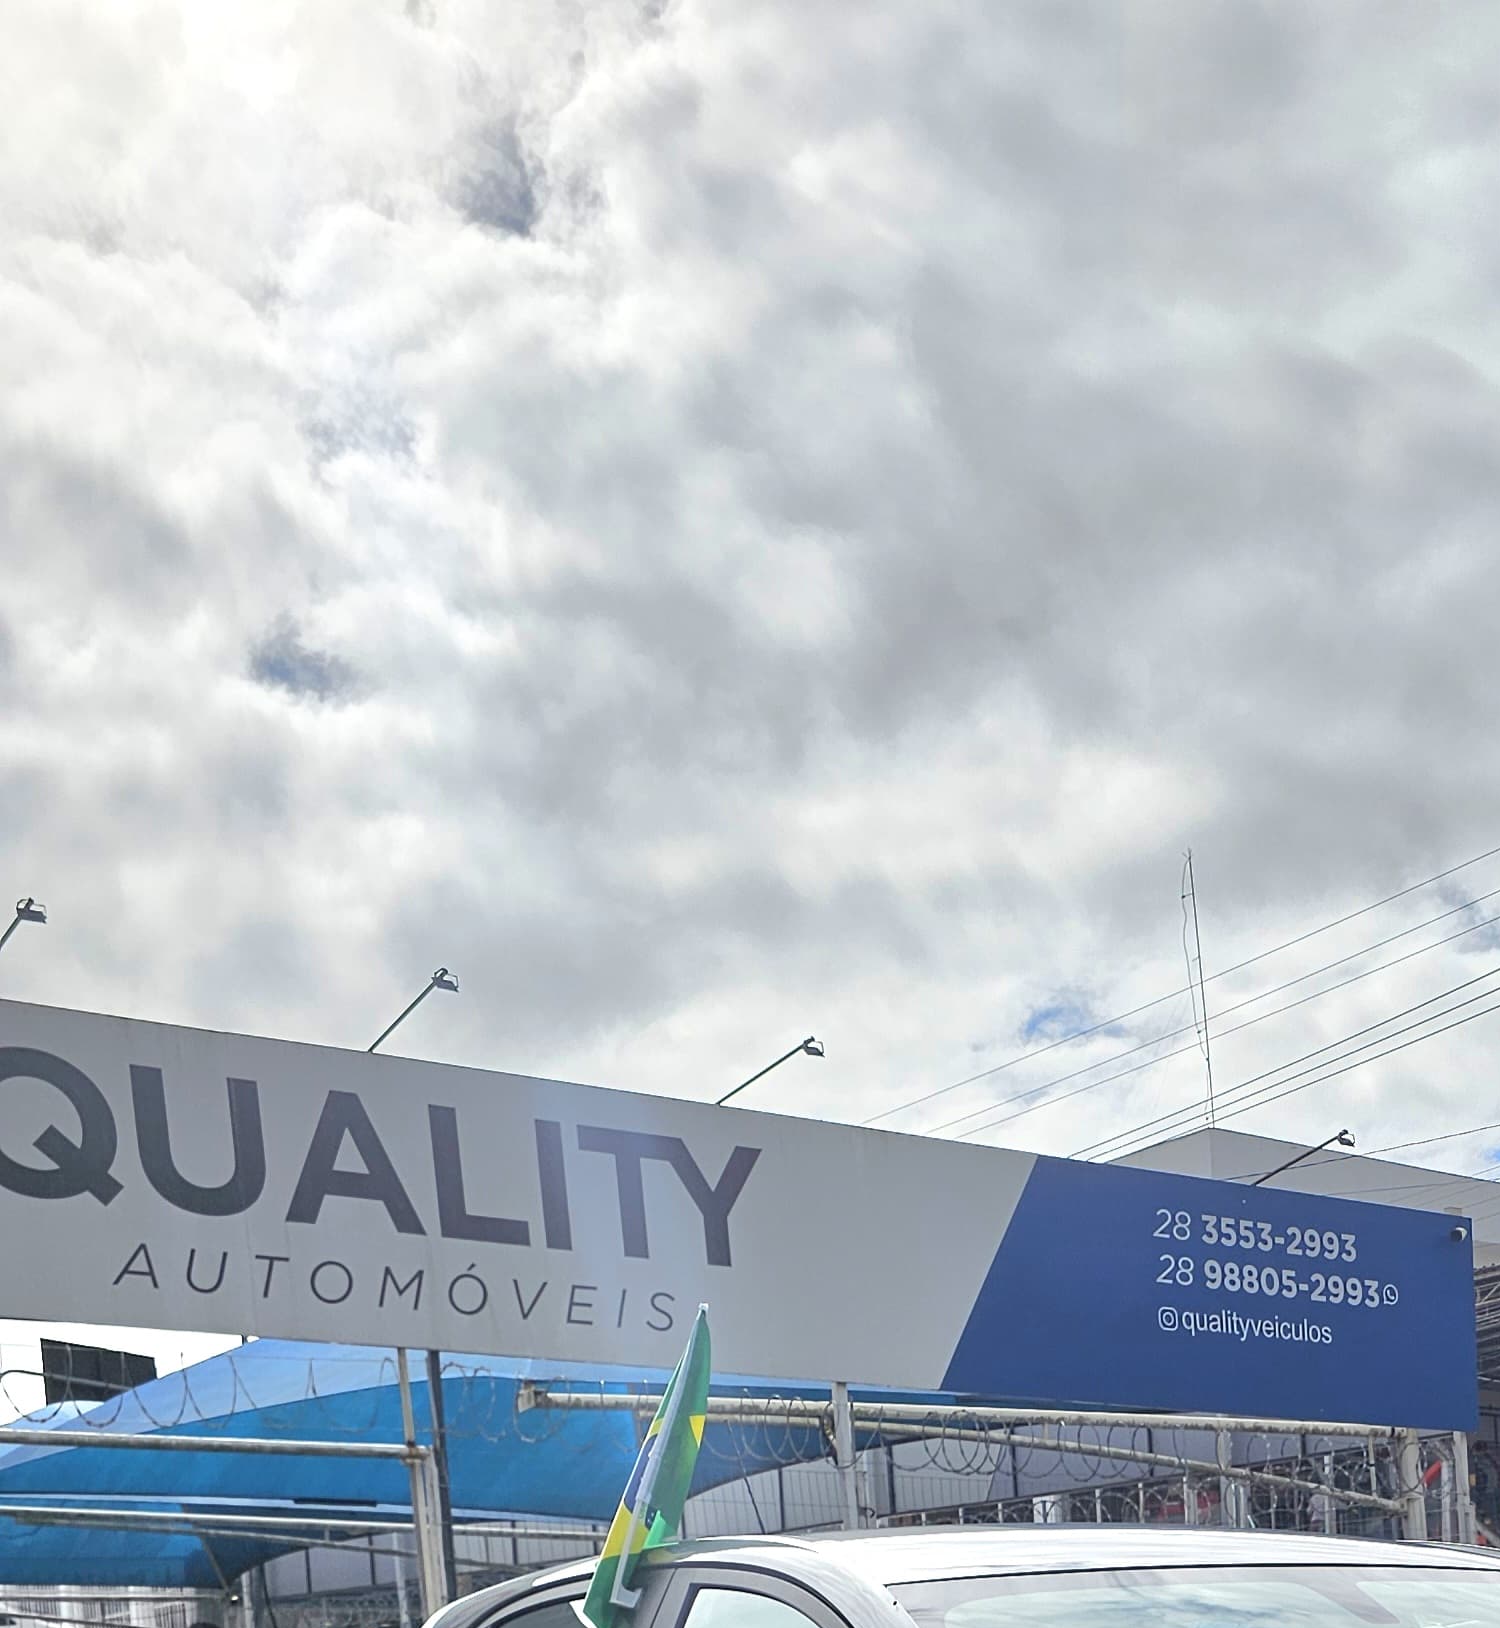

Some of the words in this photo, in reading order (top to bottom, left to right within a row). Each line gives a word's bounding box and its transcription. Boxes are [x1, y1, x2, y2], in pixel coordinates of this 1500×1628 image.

[0, 1046, 763, 1268] QUALITY
[1152, 1208, 1192, 1241] 28
[1201, 1214, 1357, 1262] 3553-2993
[113, 1243, 676, 1332] AUTOMÓVEIS
[1156, 1254, 1194, 1286] 28
[1203, 1259, 1380, 1308] 98805-2993
[1181, 1308, 1333, 1344] qualityveiculos
